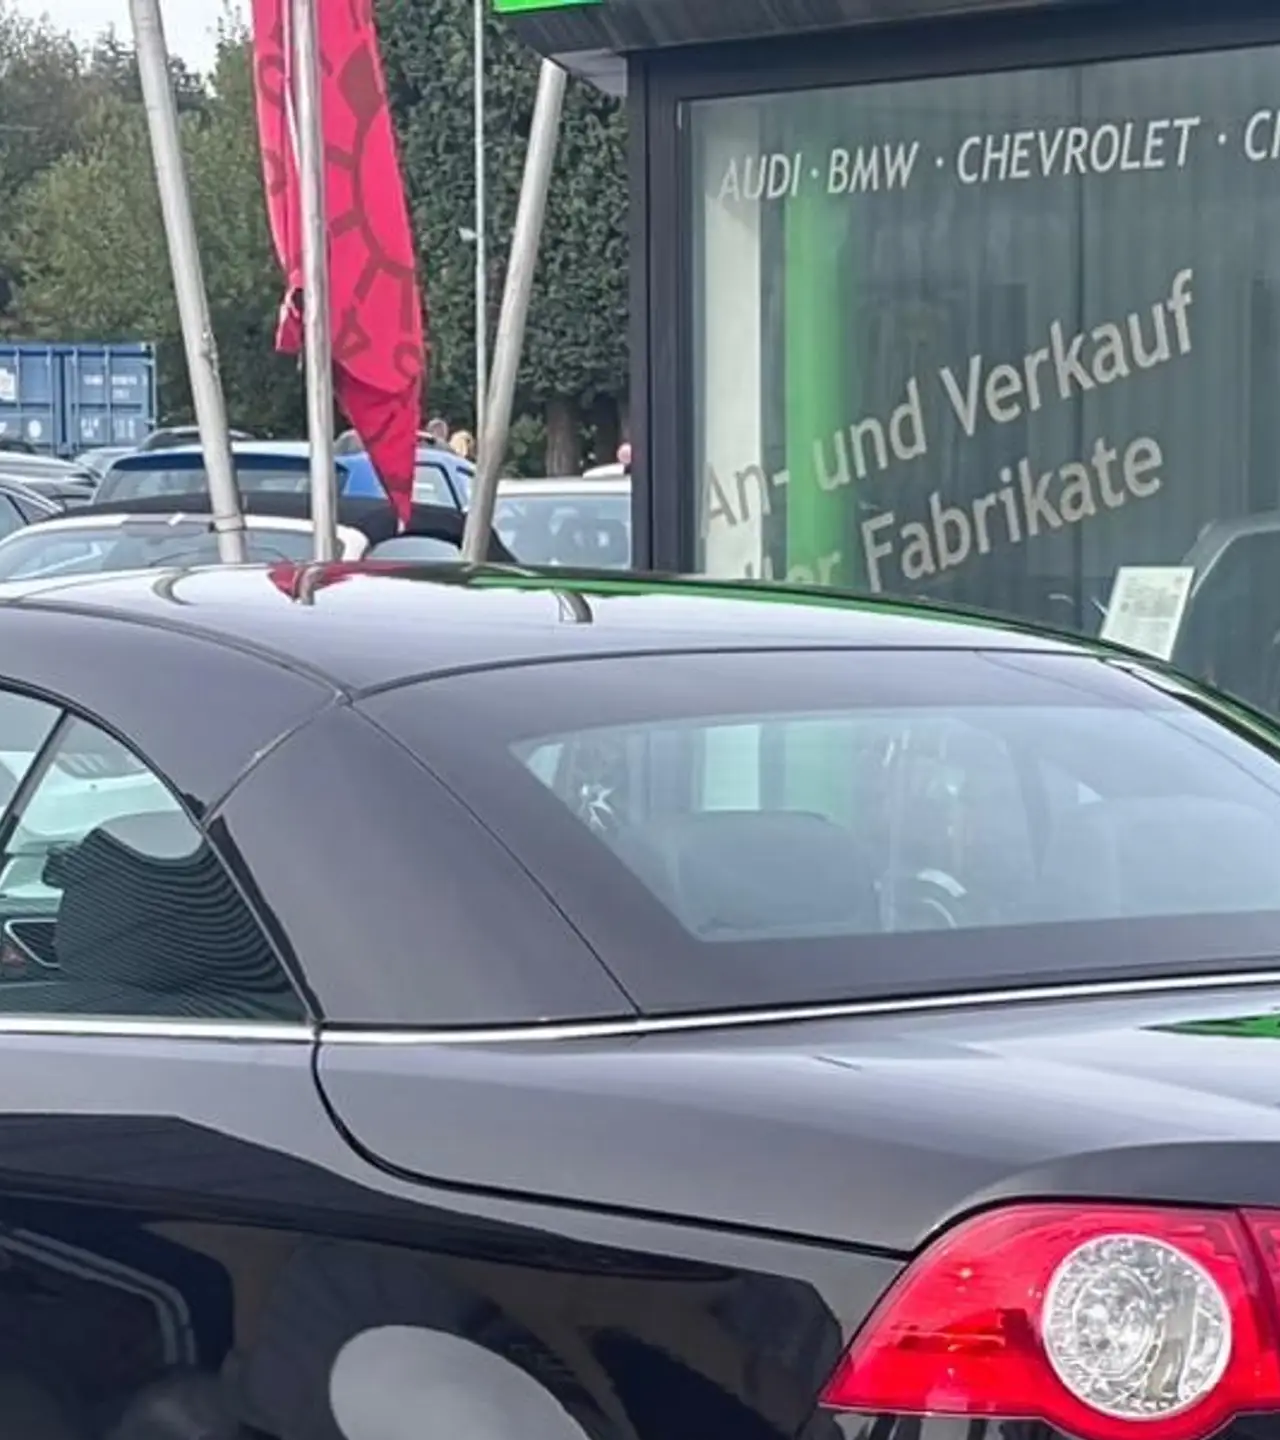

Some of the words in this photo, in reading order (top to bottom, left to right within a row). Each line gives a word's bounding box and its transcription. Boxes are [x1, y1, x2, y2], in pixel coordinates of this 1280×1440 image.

[718, 152, 803, 202] AUDI
[827, 141, 920, 195] BMW
[956, 116, 1201, 185] CHEVROLET
[812, 396, 926, 491] und
[938, 268, 1197, 439] Verkauf
[859, 431, 1165, 594] Fabrikate
